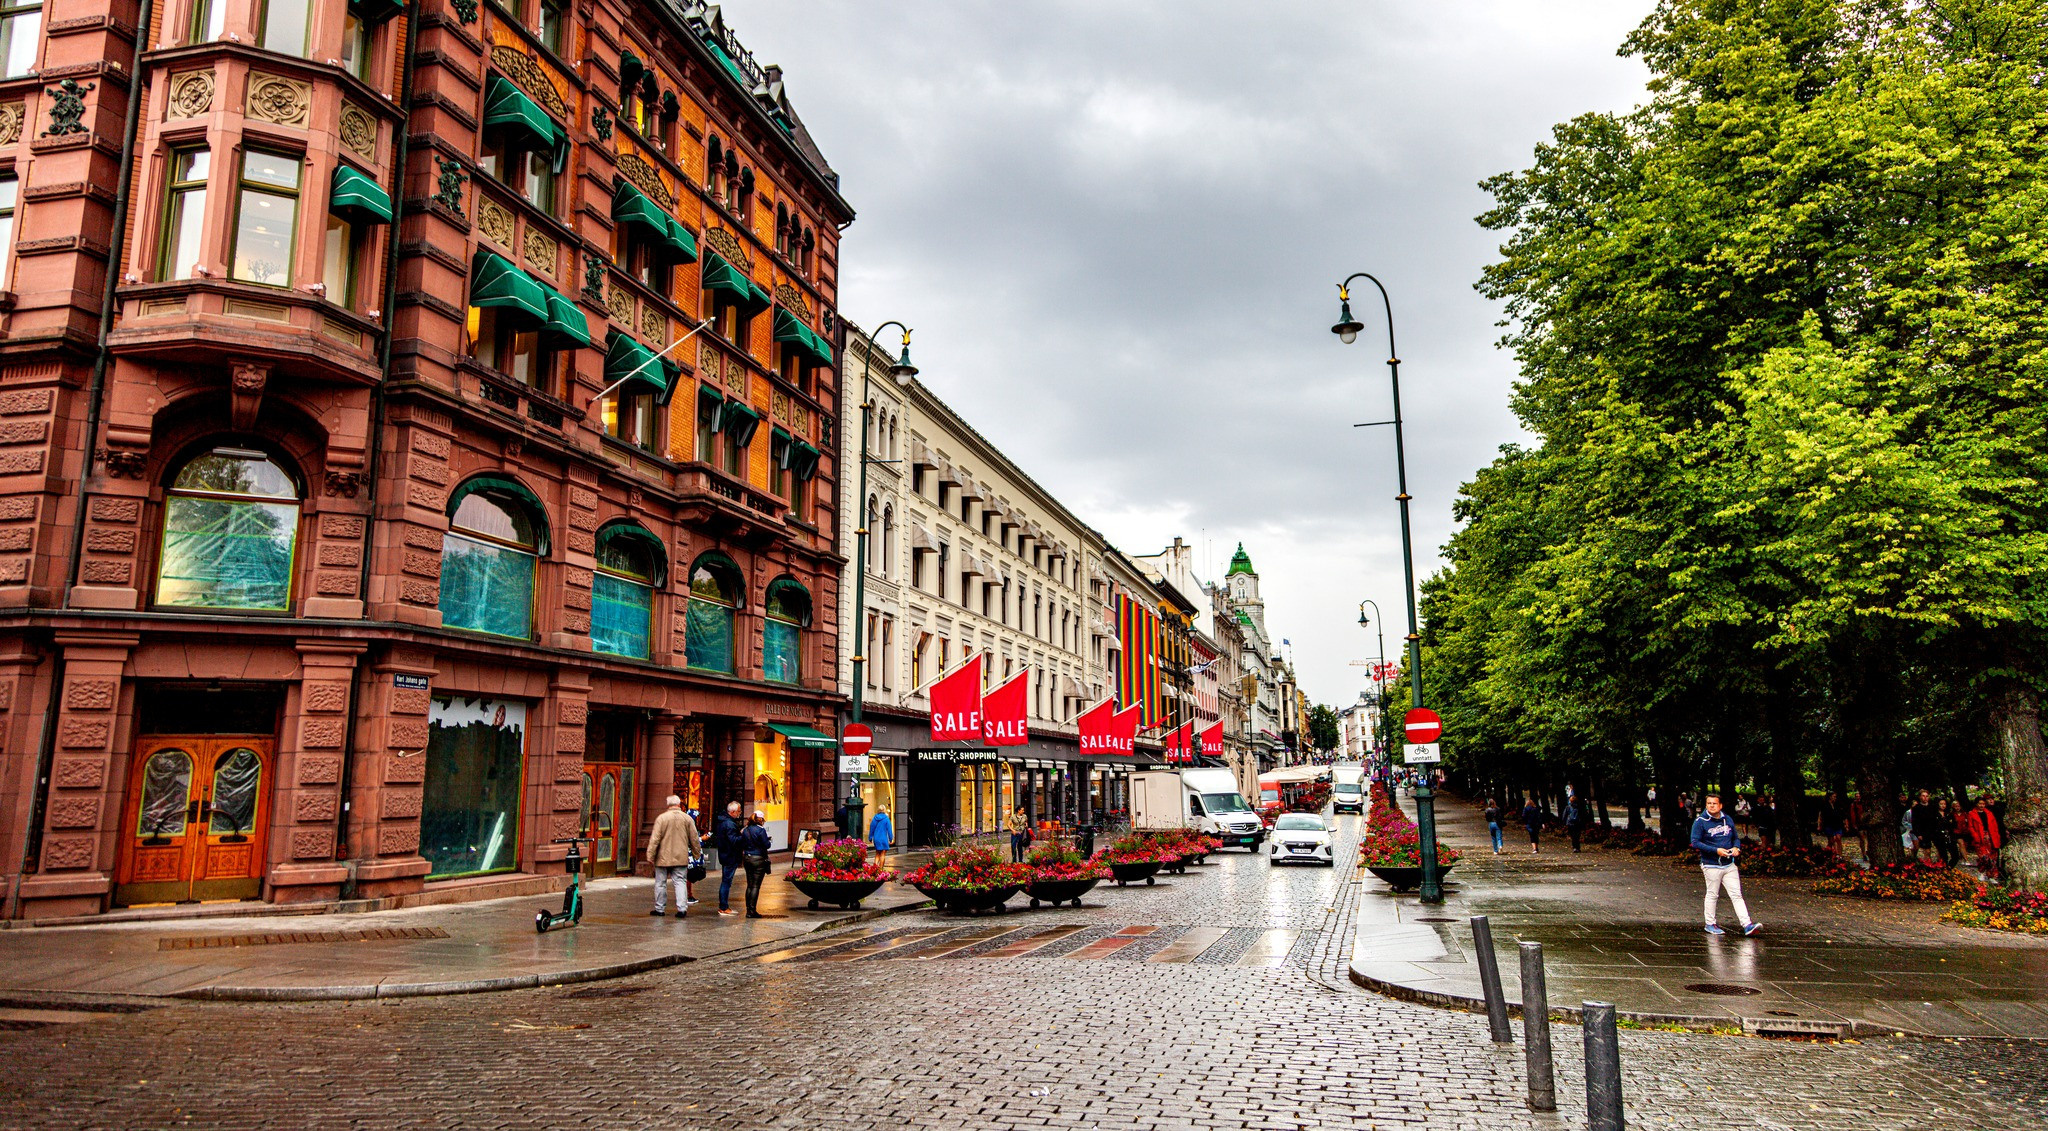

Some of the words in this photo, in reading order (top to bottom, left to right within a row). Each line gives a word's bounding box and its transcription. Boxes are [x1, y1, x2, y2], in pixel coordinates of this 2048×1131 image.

[1373, 662, 1398, 681] Frei
[765, 703, 781, 715] DALE
[933, 711, 980, 732] SALE
[985, 720, 1025, 738] SALE
[1081, 734, 1112, 749] SALE
[1112, 737, 1133, 750] ALE
[1202, 743, 1222, 752] SALE
[918, 752, 947, 760] PALEET
[959, 752, 997, 760] SHOPPING
[1168, 748, 1191, 757] SALE
